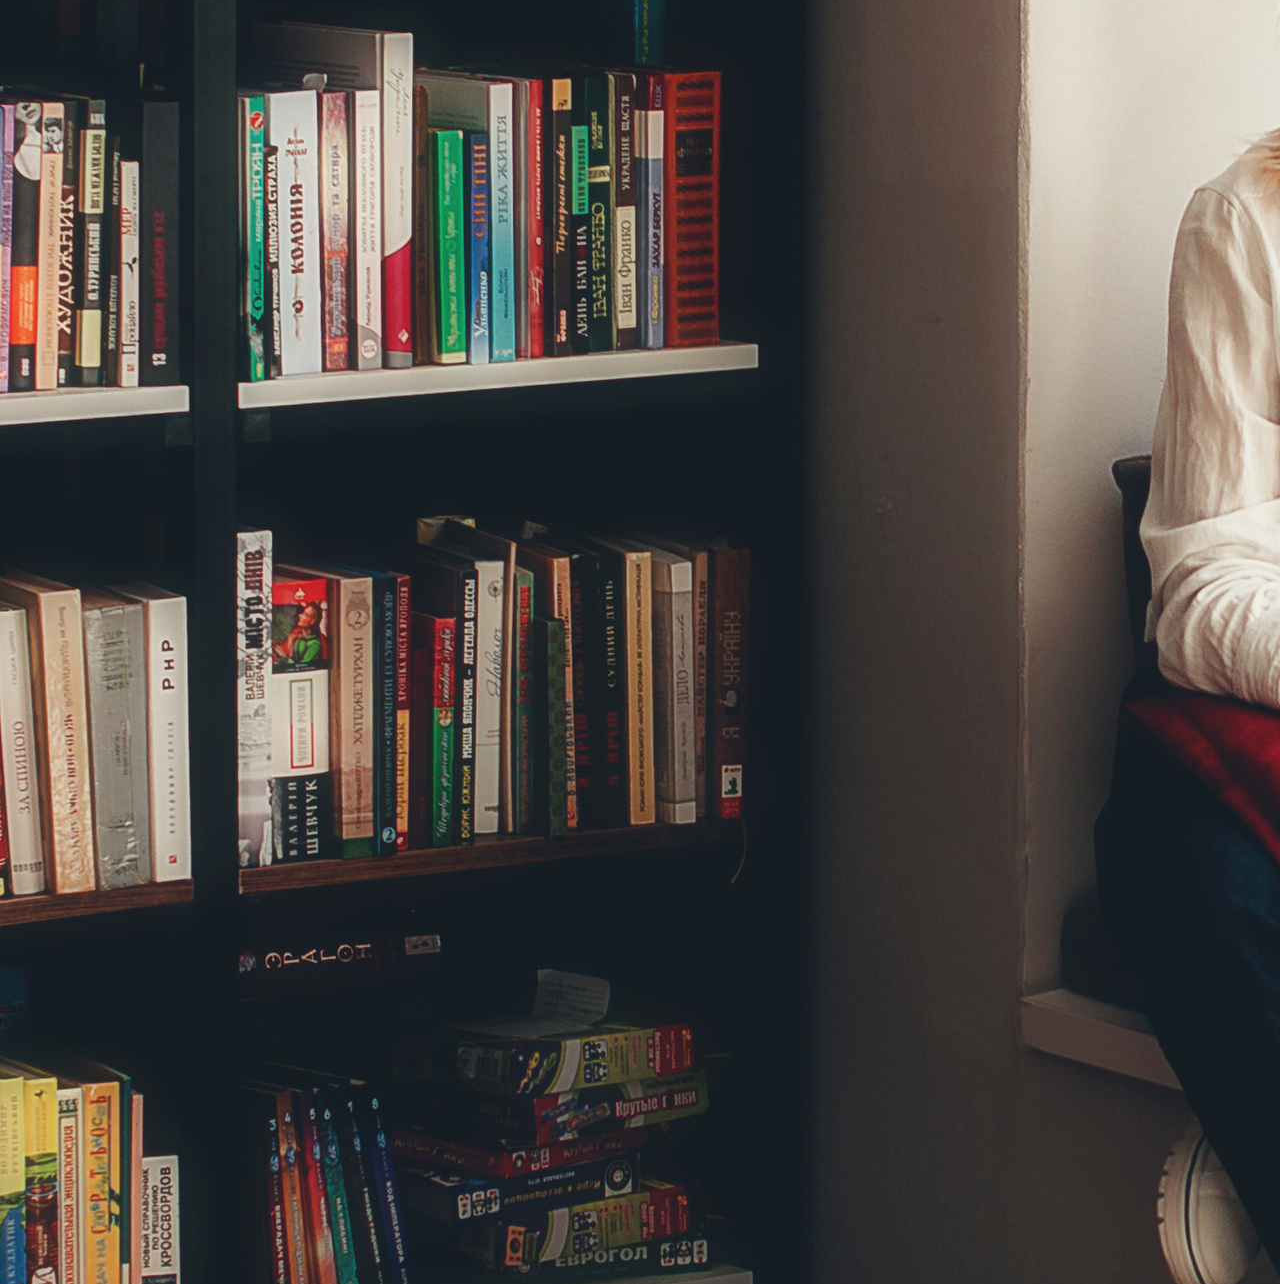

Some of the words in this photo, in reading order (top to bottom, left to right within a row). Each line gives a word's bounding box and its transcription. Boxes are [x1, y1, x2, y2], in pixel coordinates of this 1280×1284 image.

[619, 95, 630, 131] ЩАСТЯ
[472, 143, 487, 186] ТІНІ
[496, 115, 508, 180] ЖИТТЯ
[619, 136, 631, 192] УКРАДЕНЕ
[250, 142, 264, 199] ТРОЯН
[265, 154, 278, 202] СТРАХА
[121, 207, 132, 236] МЕР
[473, 191, 487, 239] СИН
[498, 184, 509, 225] РІКА
[652, 192, 661, 229] БЕРКУТ
[268, 204, 279, 263] ИЛЛЮЗИЯ
[288, 183, 305, 275] КОЛОНІЯ
[590, 201, 607, 272] ФРАНКО
[617, 220, 634, 279] Франко
[652, 229, 662, 269] ЗАХАР
[57, 195, 75, 335] ХУДОЖНИК
[575, 298, 589, 338] ДЕНЬ
[590, 278, 608, 318] ІВАН
[618, 283, 634, 315] Іван
[152, 353, 167, 366] 13
[243, 550, 266, 592] ДНІВ
[464, 578, 477, 619] ОДЕССЫ
[603, 579, 615, 621] ДЕНЬ
[243, 596, 266, 651] МІСТО
[398, 626, 408, 659] МІСТА
[463, 620, 476, 666] ЛЕГЕНДА
[352, 636, 364, 685] ТУРХАН
[604, 625, 618, 689] СУДНИЙ
[717, 610, 741, 686] УКРАЇНУ
[244, 655, 257, 701] ВАЛЕРІЙ
[254, 654, 266, 701] ШЕВЧУК
[398, 660, 408, 703] ХРОНІКА
[676, 668, 691, 706] ДЕЛО
[296, 684, 308, 724] РОМАНИ
[383, 678, 394, 740] ФРАГМЕНТИ
[463, 678, 475, 725] ЯПОНЧИК
[12, 720, 29, 793] СПИНОЮ
[297, 727, 309, 763] ЧОТИРИ
[461, 726, 474, 759] МИША
[18, 795, 31, 815] ЗА
[461, 764, 473, 805] ЮЖНЫЙ
[287, 781, 299, 857] ВАЛЕРІЙ
[304, 778, 320, 856] ШЕВЧУК
[460, 807, 472, 839] БОРИС
[616, 1097, 660, 1119] Крутые
[141, 1167, 150, 1231] СПРАВОЧНИК
[151, 1184, 160, 1234] РЕШЕНИЮ
[160, 1165, 174, 1267] КРОССВОРДОВ
[96, 1236, 108, 1260] НА
[141, 1232, 151, 1269] НОВЫЙ
[151, 1235, 160, 1251] ПО
